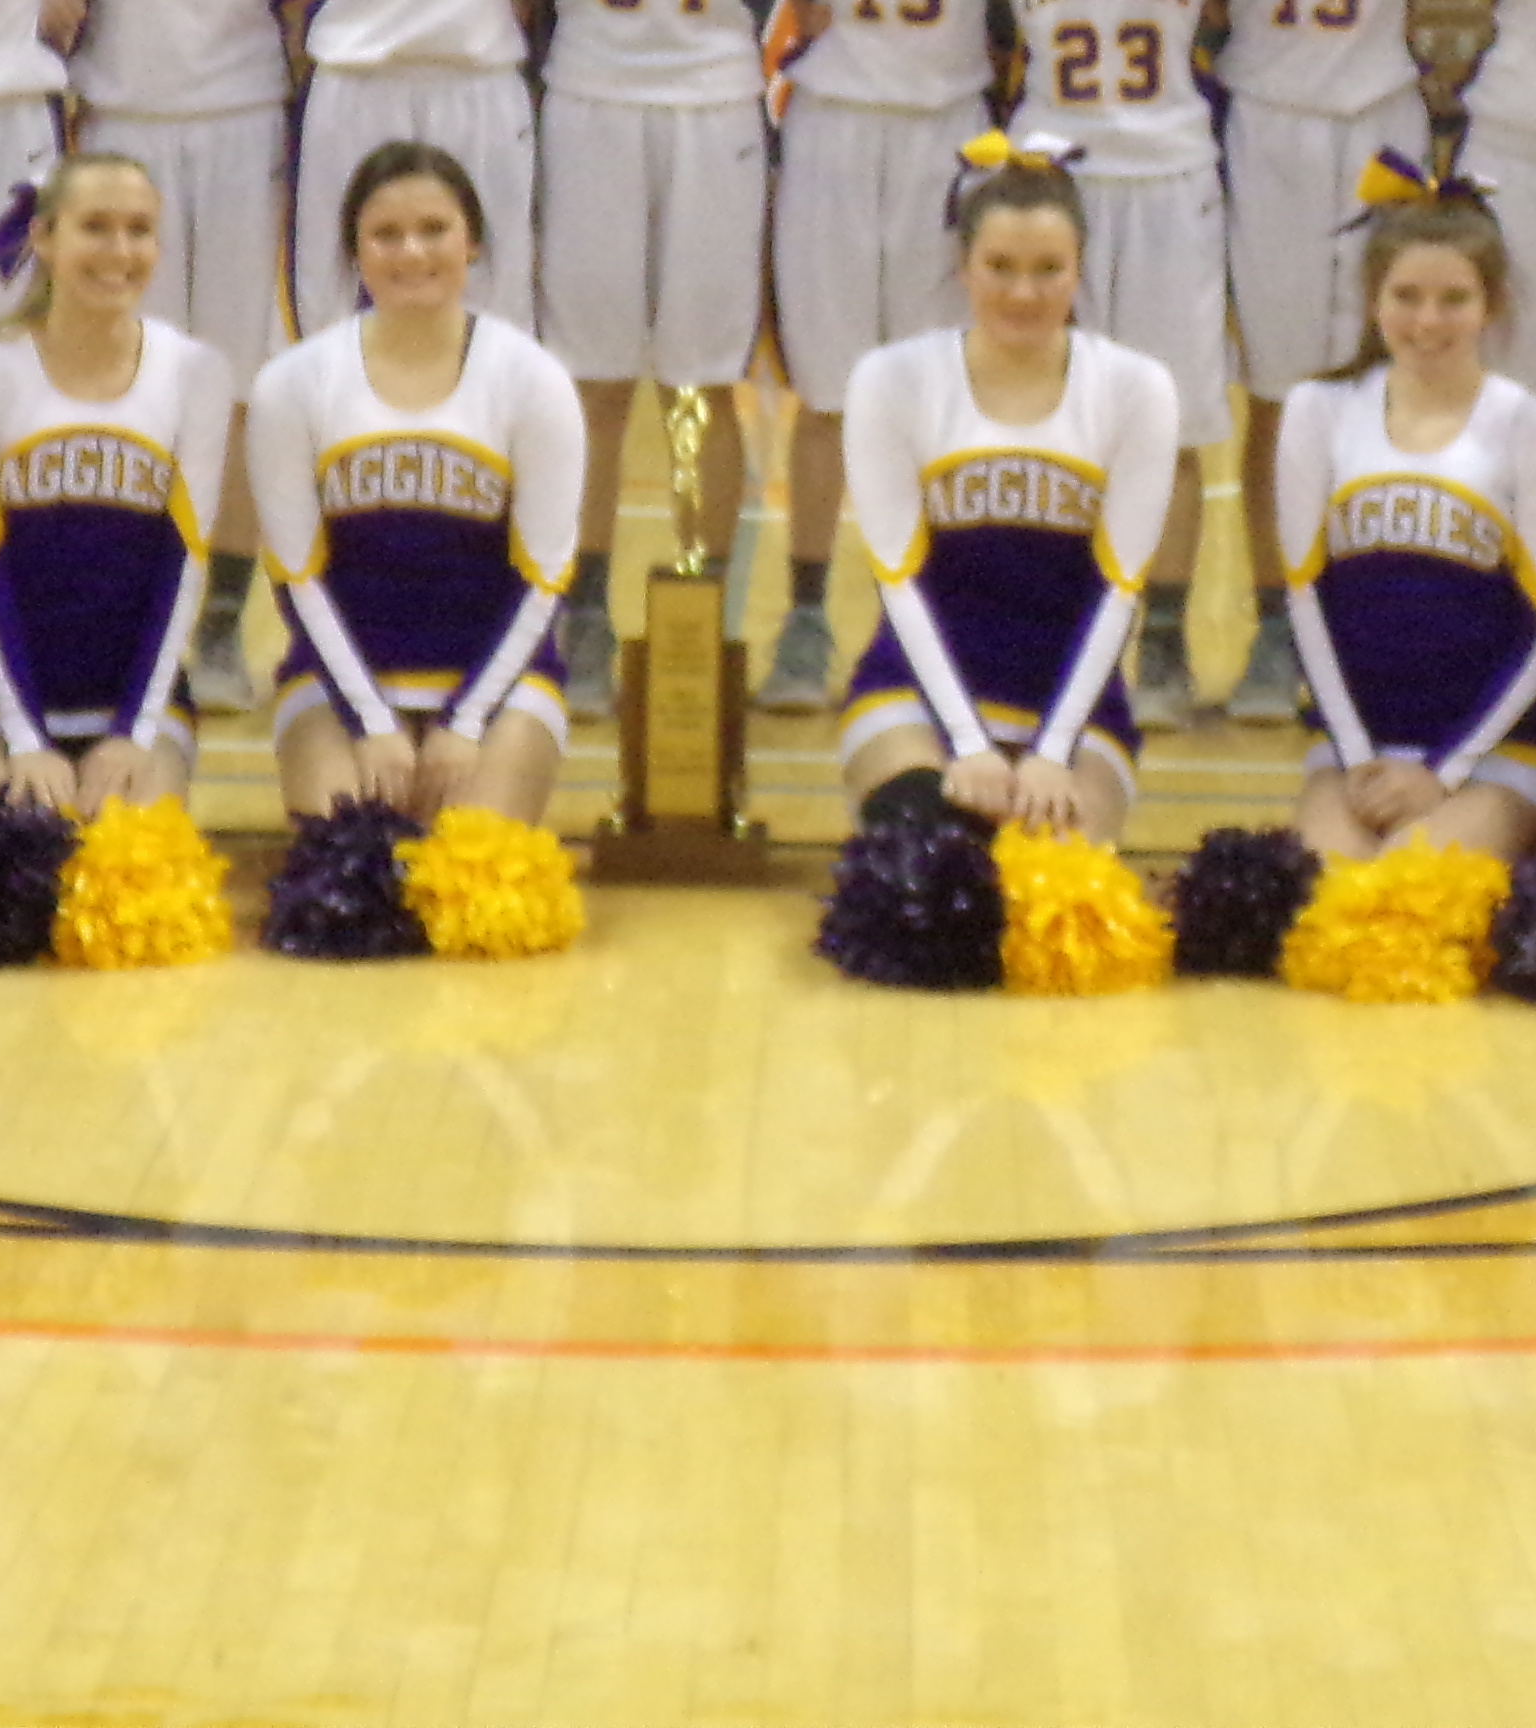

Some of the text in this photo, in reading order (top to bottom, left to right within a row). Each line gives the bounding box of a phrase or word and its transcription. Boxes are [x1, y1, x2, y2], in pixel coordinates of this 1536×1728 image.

[1052, 18, 1165, 106] 23
[0, 437, 173, 510] AGGIES
[323, 440, 504, 518] AGGIES
